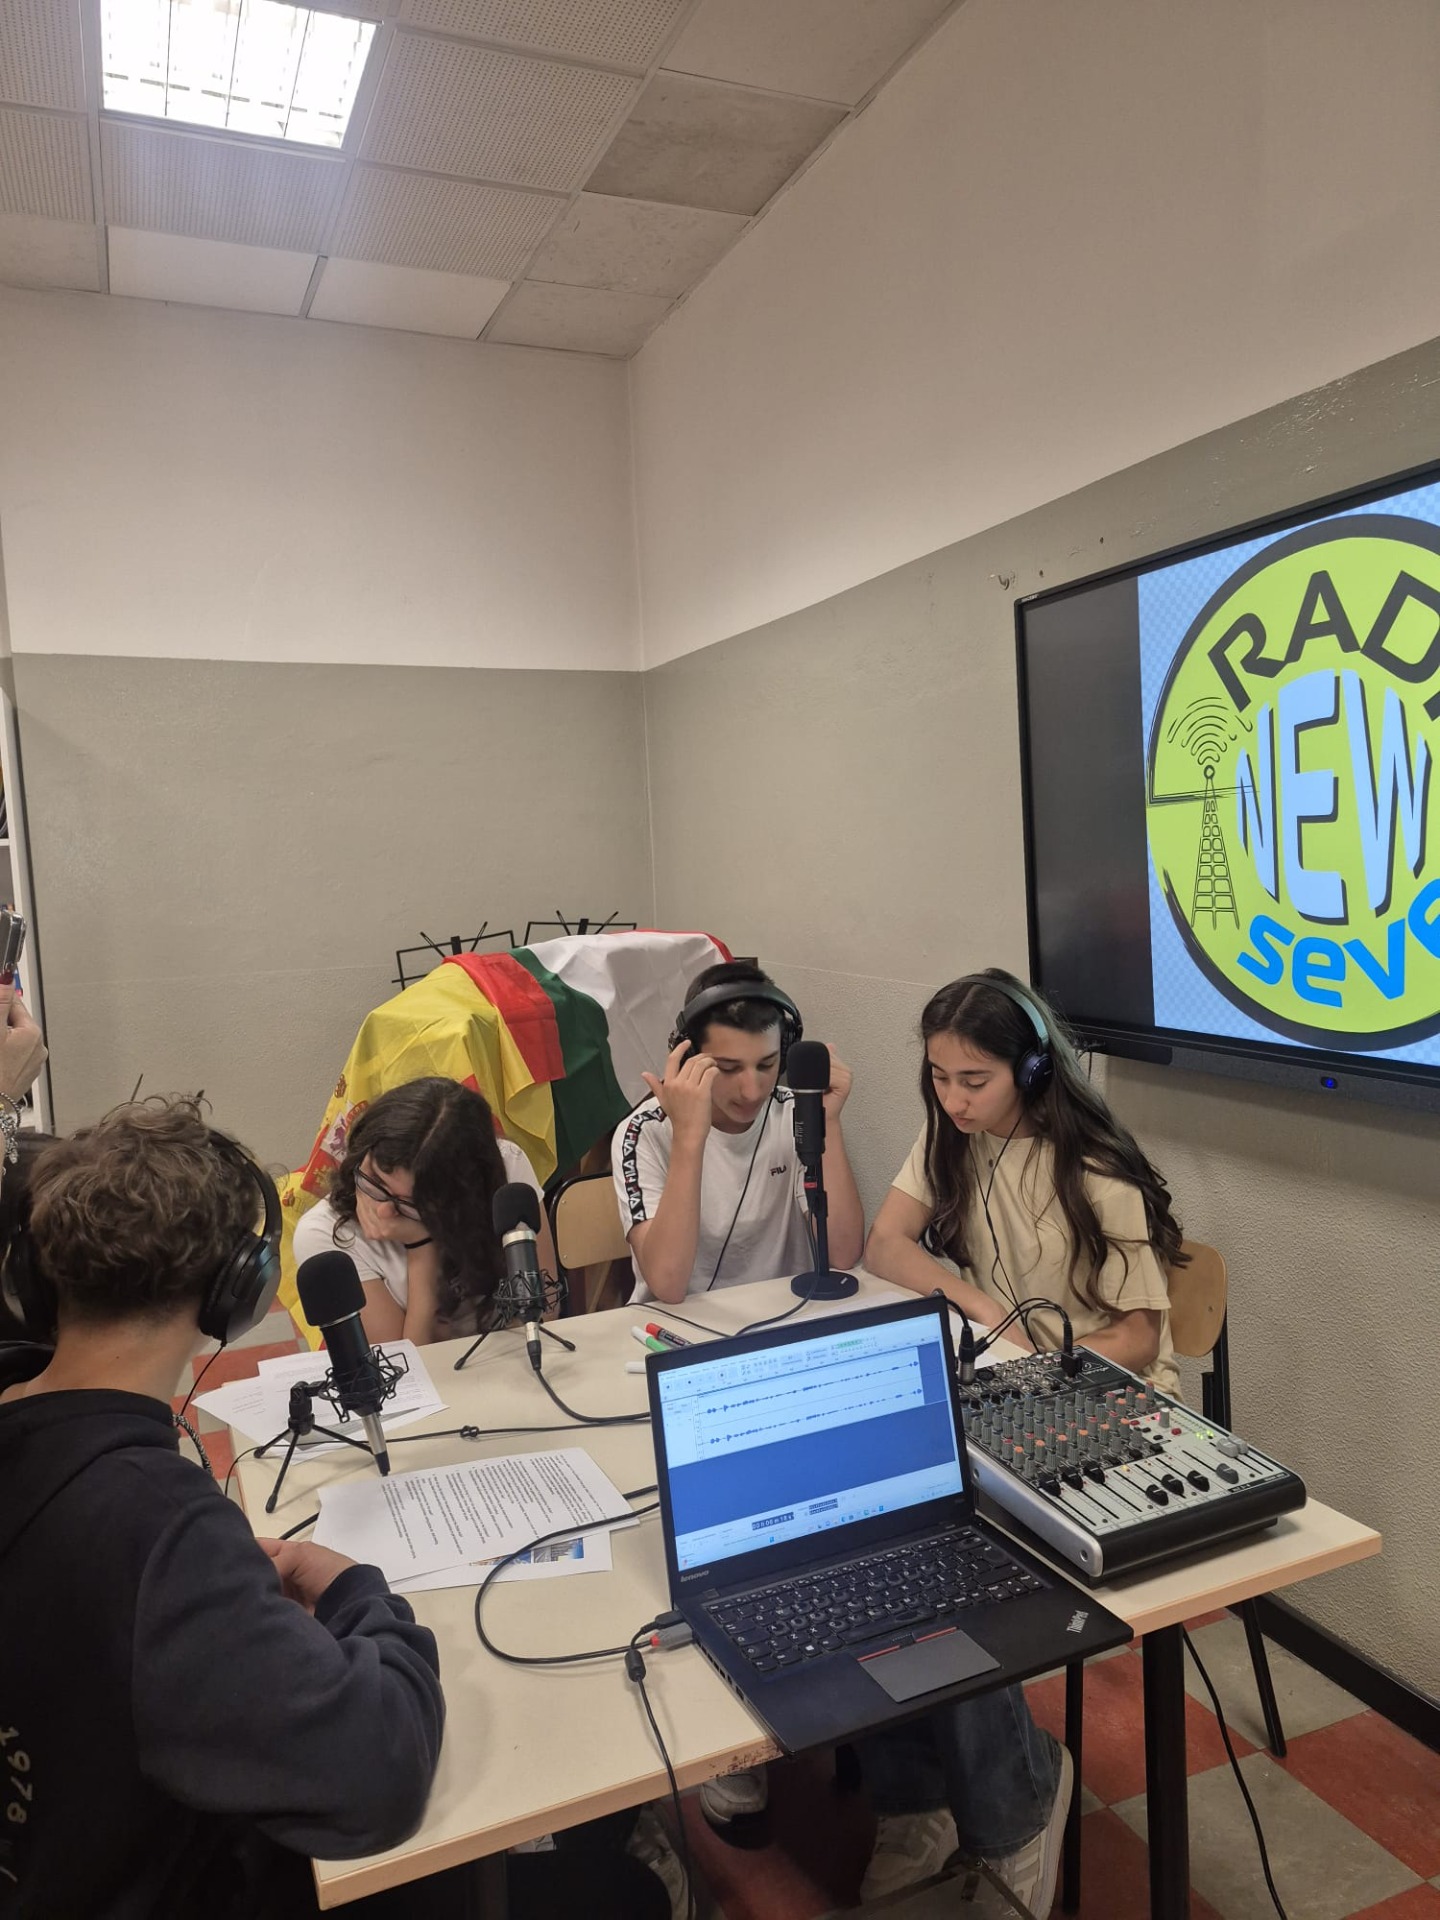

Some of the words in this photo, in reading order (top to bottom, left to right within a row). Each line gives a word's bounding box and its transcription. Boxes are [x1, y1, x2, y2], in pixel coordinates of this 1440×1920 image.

[1208, 570, 1440, 722] RAD
[1236, 668, 1433, 927] NEW
[0, 1726, 33, 1824] 1978
